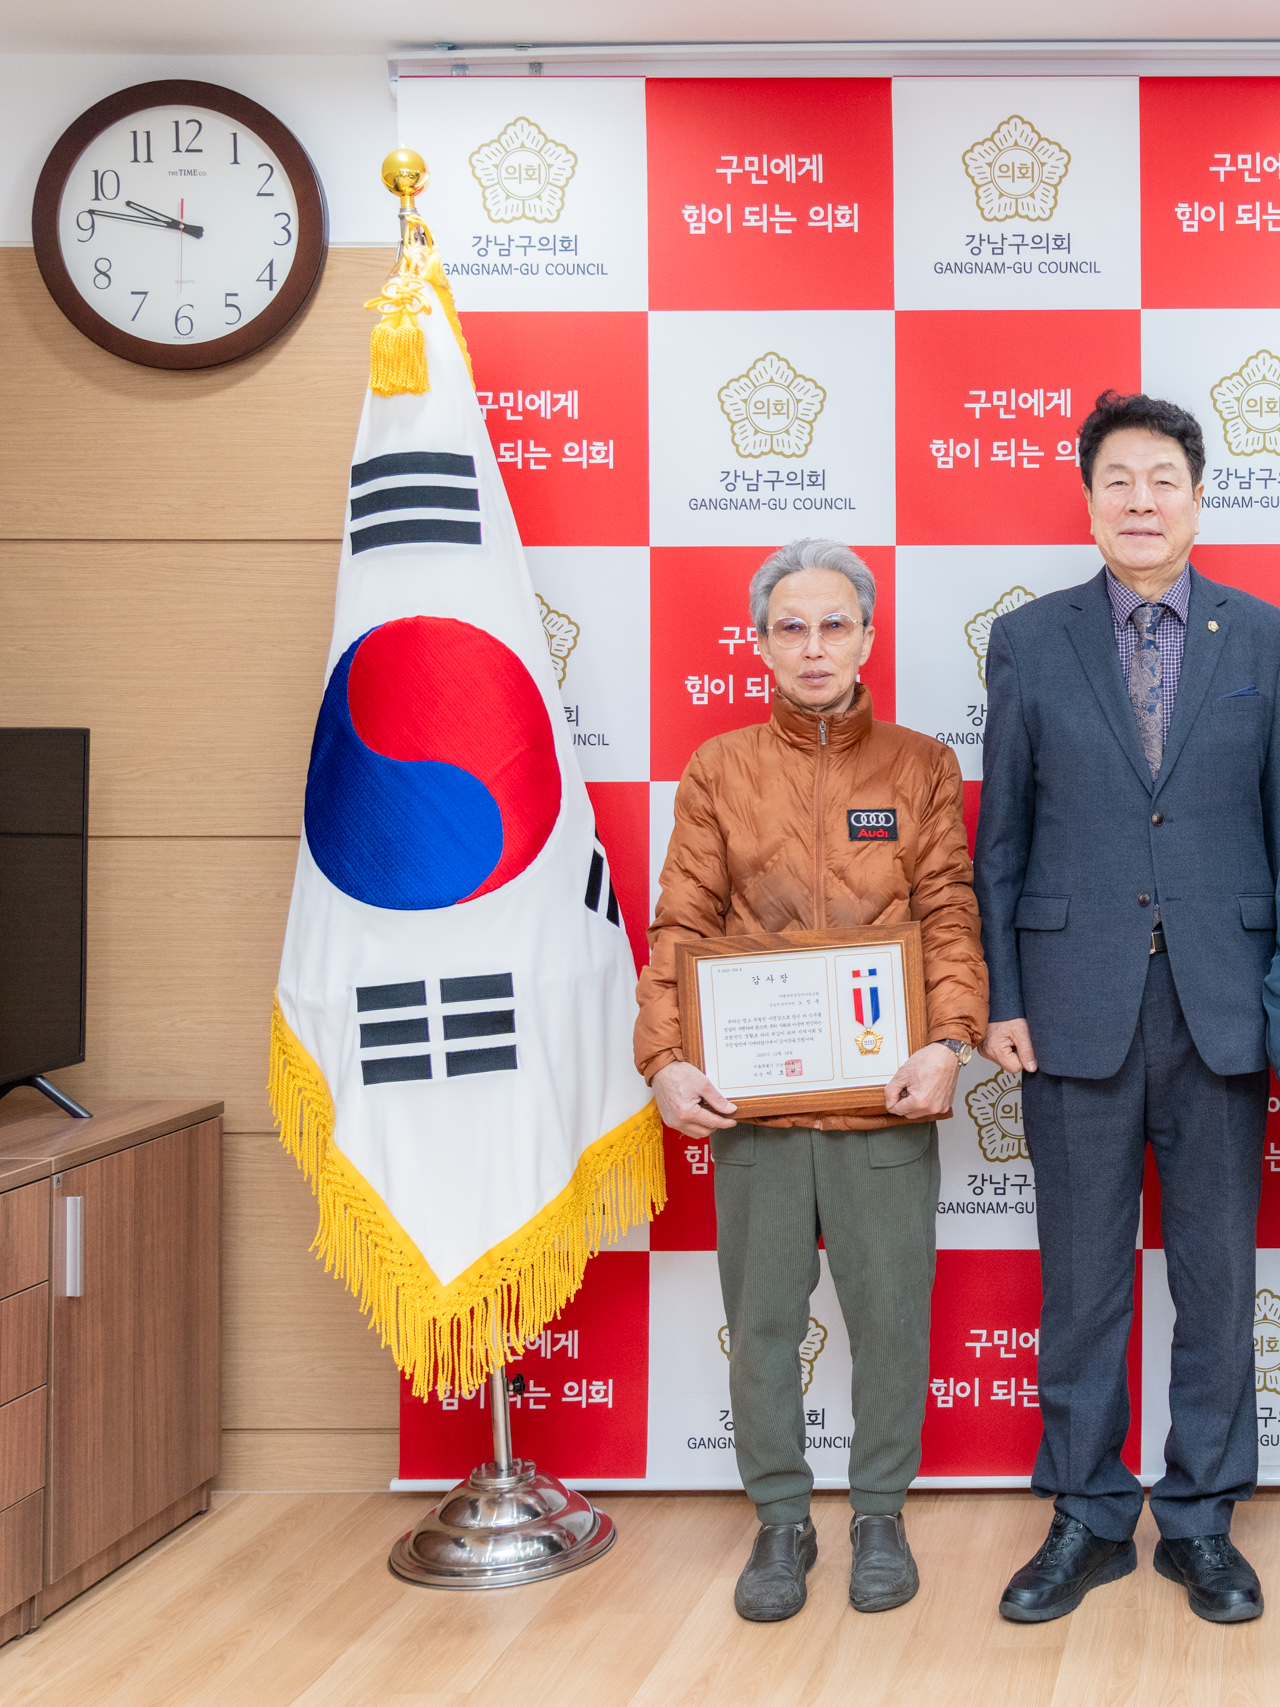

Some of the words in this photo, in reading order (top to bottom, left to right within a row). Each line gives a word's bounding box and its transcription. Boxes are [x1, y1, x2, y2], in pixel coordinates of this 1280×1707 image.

[130, 130, 154, 163] 11
[171, 119, 203, 153] 12
[229, 132, 240, 165] 1
[256, 163, 275, 197] 2
[505, 162, 544, 185] 의회
[716, 153, 826, 185] 구민에게
[997, 160, 1036, 183] 의회
[91, 169, 120, 201] 10
[76, 211, 96, 243] 9
[273, 212, 292, 246] 3
[682, 203, 733, 235] 힘이
[743, 203, 798, 234] 되는
[808, 202, 860, 233] 의회
[1174, 201, 1225, 233] 힘이
[472, 234, 578, 257] 강남구의회
[964, 232, 1071, 255] 강남구의회
[93, 257, 112, 290] 8
[255, 258, 278, 291] 4
[443, 262, 540, 276] GANGNAM-GU
[545, 262, 608, 275] COUNCIL
[933, 260, 1032, 275] GANGNAM-GU
[1038, 260, 1101, 274] COUNCIL
[130, 291, 149, 322] 7
[174, 303, 194, 336] 6
[224, 292, 242, 325] 5
[475, 389, 578, 420] 구민에게
[751, 397, 790, 420] 의회
[962, 388, 1072, 420] 구민에게
[498, 439, 552, 469] 되는
[562, 439, 614, 469] 의회
[928, 438, 979, 470] 힘이
[989, 438, 1044, 469] 되는
[1055, 437, 1081, 468] 의
[718, 469, 825, 492] 강남구의회
[687, 497, 786, 512] GANGNAM-GU
[792, 497, 855, 511] COUNCIL
[1202, 495, 1280, 508] NGNAM-GU
[684, 674, 734, 704] 힘이
[744, 674, 775, 704] 되
[936, 732, 985, 745] GANGN
[857, 828, 889, 838] Audi
[1000, 1102, 1022, 1124] 의
[684, 1144, 714, 1175] 힘
[967, 1173, 1036, 1196] 강남구
[937, 1201, 1035, 1214] GANGNAM-GU
[965, 1328, 1040, 1358] 구민에
[562, 1378, 613, 1408] 의회
[930, 1377, 979, 1408] 힘이
[990, 1377, 1040, 1408] 되는
[687, 1437, 735, 1449] GANGN
